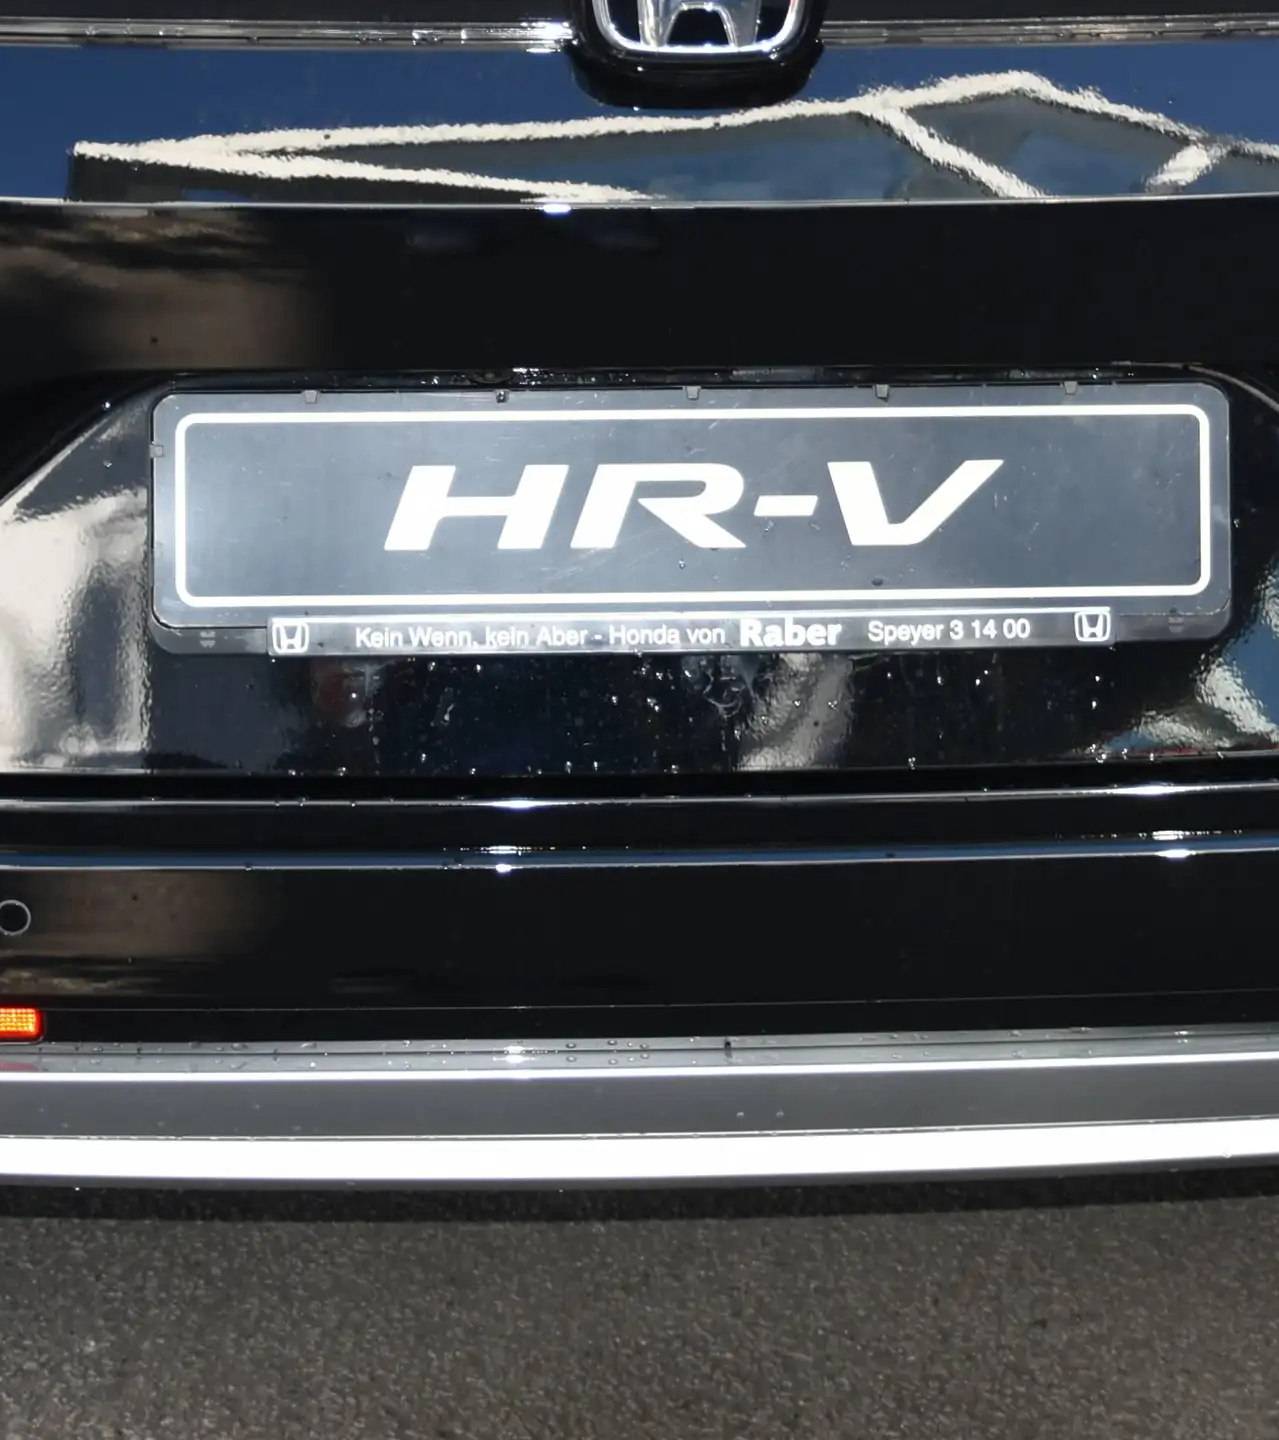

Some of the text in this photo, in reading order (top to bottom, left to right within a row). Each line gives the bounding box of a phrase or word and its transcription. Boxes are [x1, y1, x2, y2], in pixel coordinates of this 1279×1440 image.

[383, 459, 1005, 551] HR-V
[355, 627, 404, 648] Kein
[408, 627, 478, 650] Wenn,
[485, 625, 529, 648] kein
[535, 625, 587, 646] Aber
[608, 624, 680, 645] Honda
[686, 626, 726, 643] von
[739, 618, 842, 647] Raber
[867, 620, 944, 643] Speyer
[950, 620, 963, 640] 3
[972, 619, 998, 639] 14
[1002, 618, 1031, 639] 00
